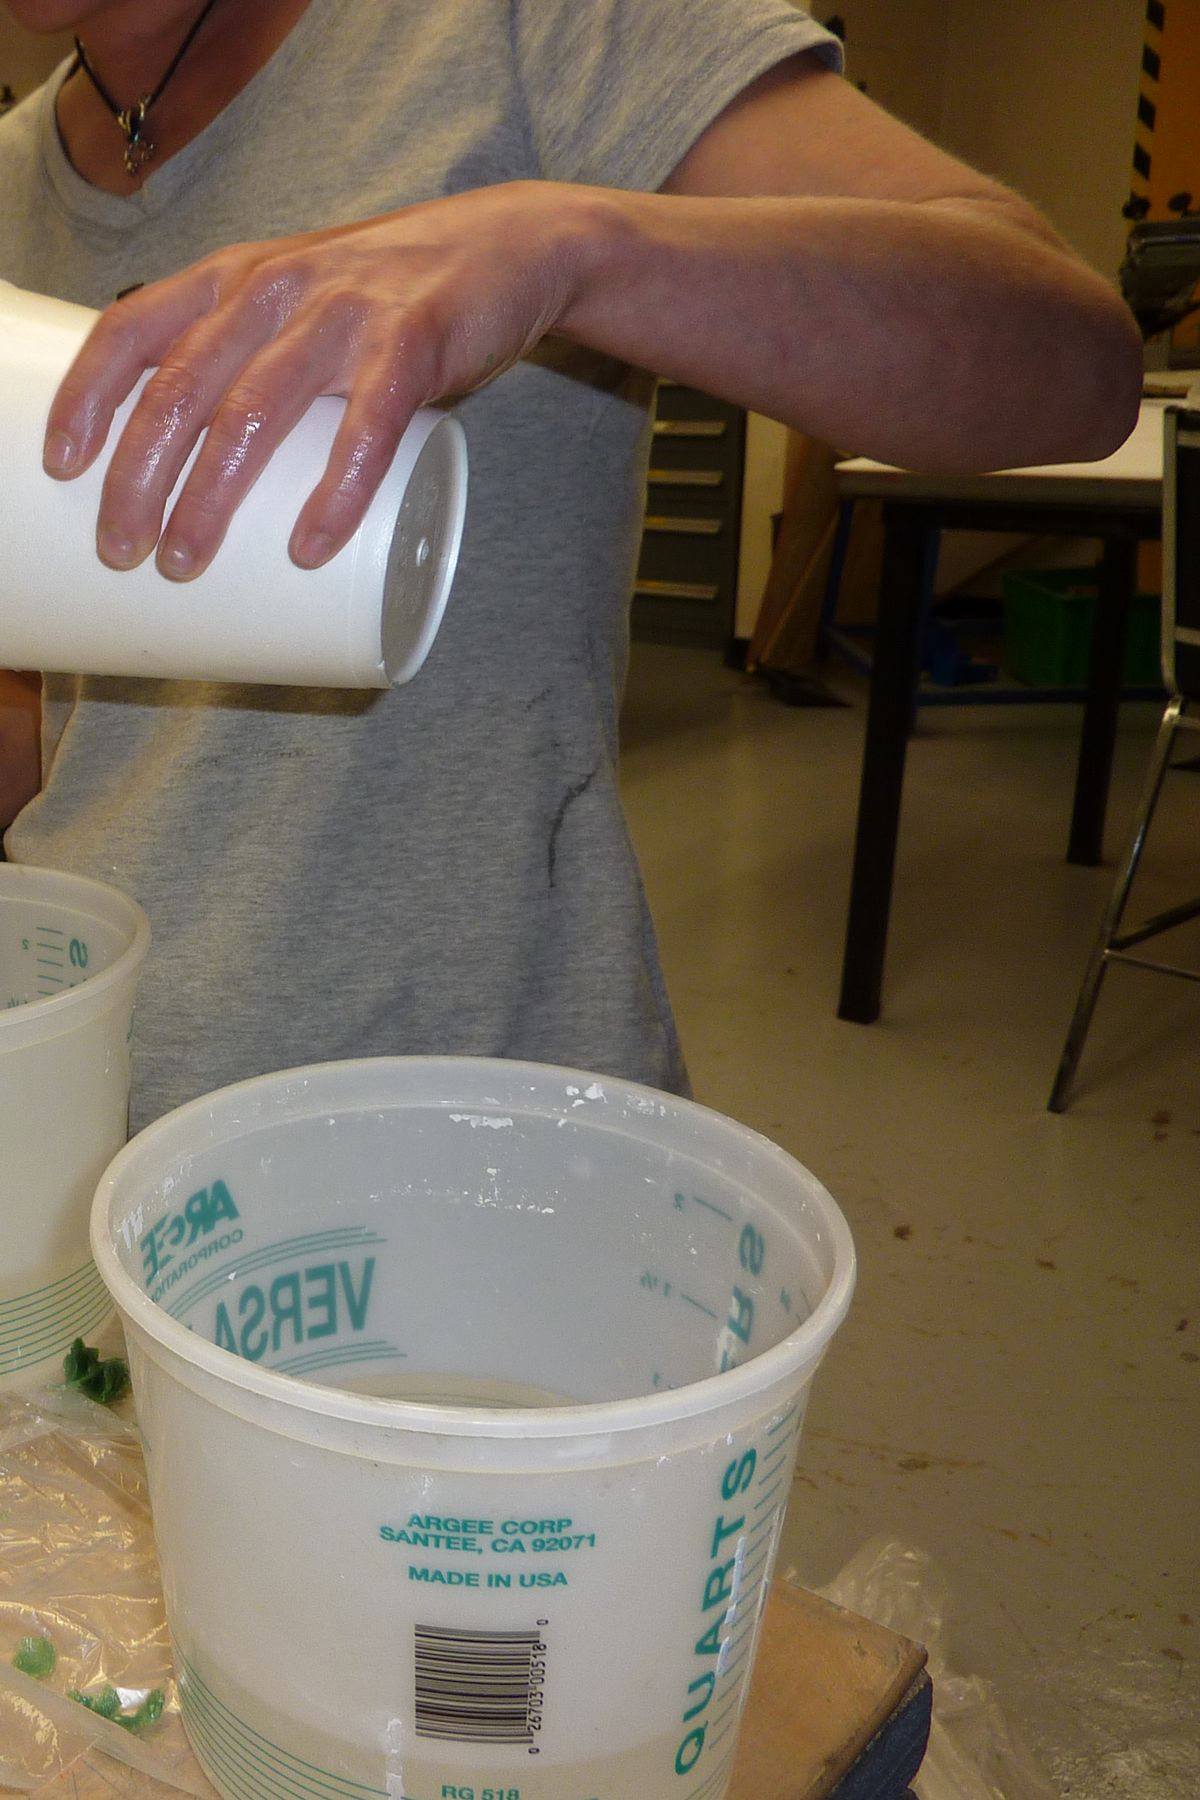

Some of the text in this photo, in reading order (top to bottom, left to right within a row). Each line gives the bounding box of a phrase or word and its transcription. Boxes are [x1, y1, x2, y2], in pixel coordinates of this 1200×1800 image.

[407, 1513, 572, 1535] ARGEE CORP
[379, 1526, 596, 1554] SANTEE, CA 92071
[408, 1566, 569, 1588] MADE IN USA
[674, 1447, 757, 1777] QUARTS
[481, 1788, 521, 1800] 518
